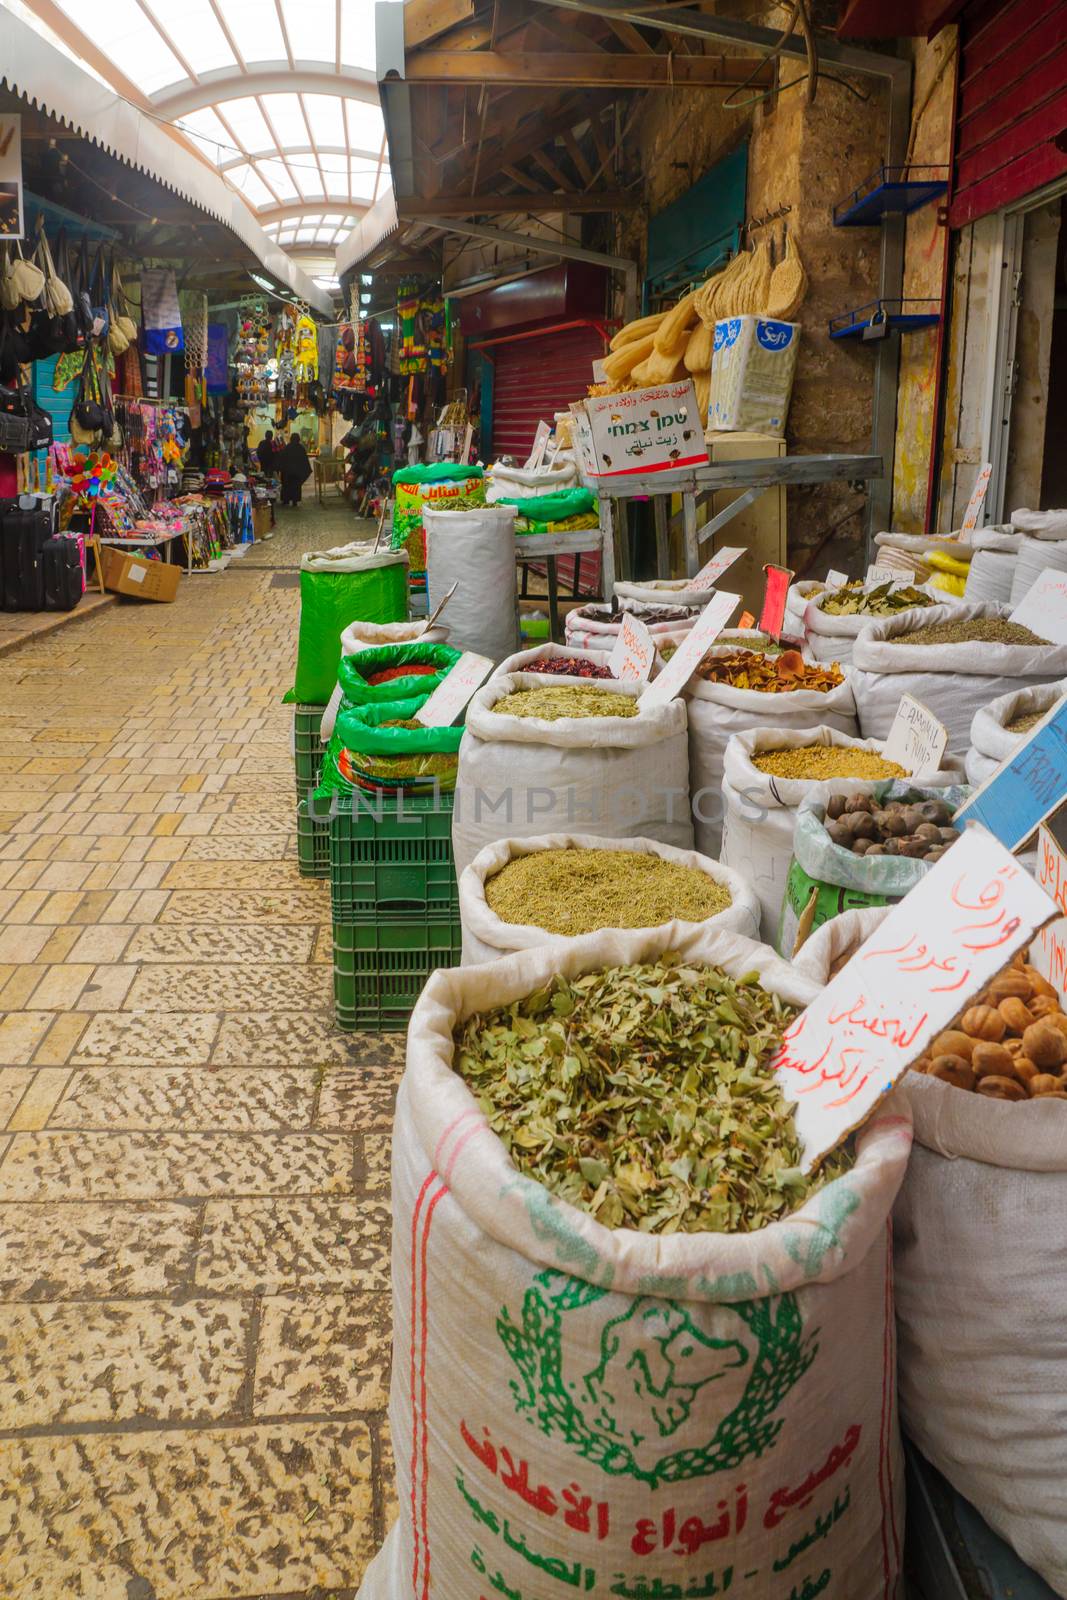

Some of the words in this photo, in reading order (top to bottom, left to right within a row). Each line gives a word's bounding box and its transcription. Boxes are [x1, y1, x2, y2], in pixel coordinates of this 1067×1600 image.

[607, 419, 651, 438] צמחי
[624, 437, 653, 457] نباتي
[655, 433, 679, 446] زيت
[656, 412, 688, 431] שמן
[951, 864, 1021, 951] ورق
[460, 1418, 610, 1541] الأعلاف
[763, 1424, 862, 1529] جميع
[455, 1464, 597, 1592] الصناعية
[631, 1484, 749, 1557] أنواع
[772, 1484, 851, 1573] نابلس
[610, 1565, 734, 1600] المنطقة
